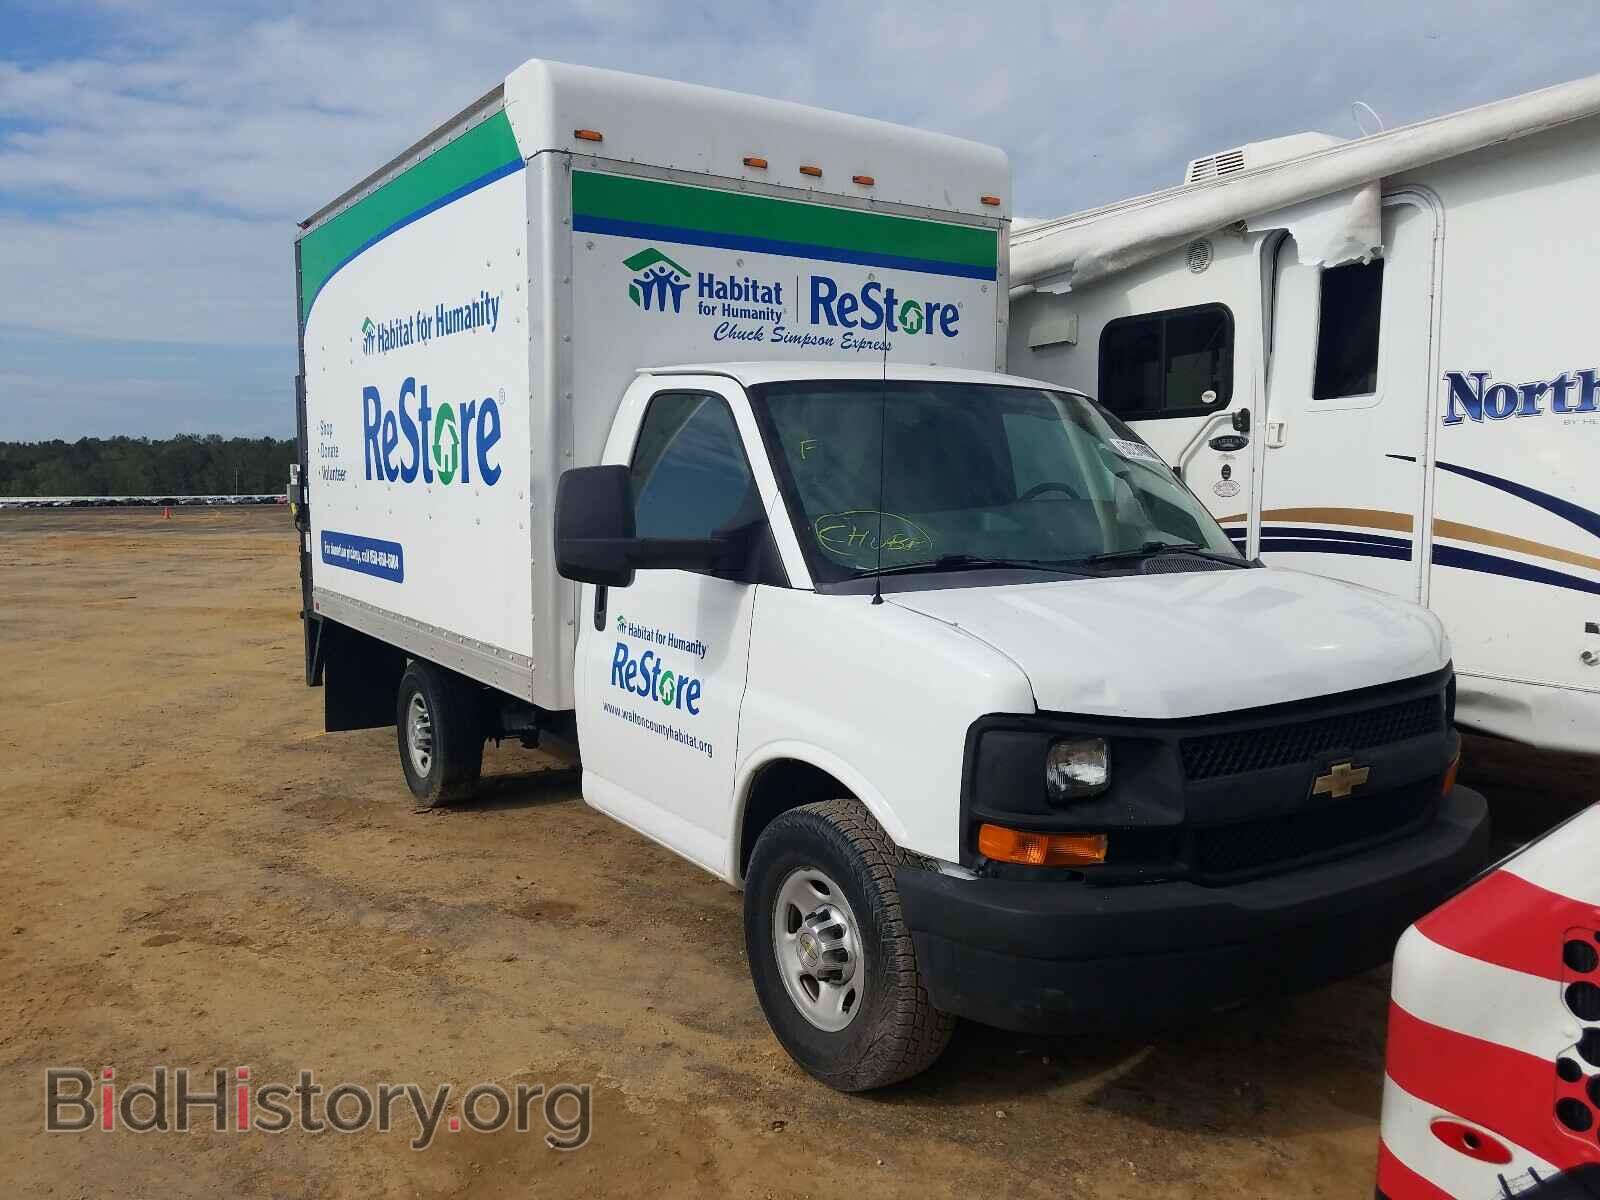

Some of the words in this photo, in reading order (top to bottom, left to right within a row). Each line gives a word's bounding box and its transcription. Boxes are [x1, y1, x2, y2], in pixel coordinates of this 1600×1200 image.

[698, 272, 783, 305] Habitat
[698, 301, 717, 318] for
[721, 304, 783, 325] Humanity
[809, 275, 960, 338] ReStore
[377, 314, 414, 354] Habitat
[416, 309, 433, 343] for
[435, 289, 500, 338] Humanity
[713, 321, 765, 343] Chuck
[770, 326, 836, 349] Simpson
[840, 331, 893, 353] Express
[361, 376, 502, 487] ReStore
[628, 622, 654, 643] Habitat
[655, 628, 667, 647] for
[667, 632, 708, 660] Humanity
[611, 641, 701, 716] ReStore
[602, 700, 714, 759] www.waltoncountyhabitat.org
